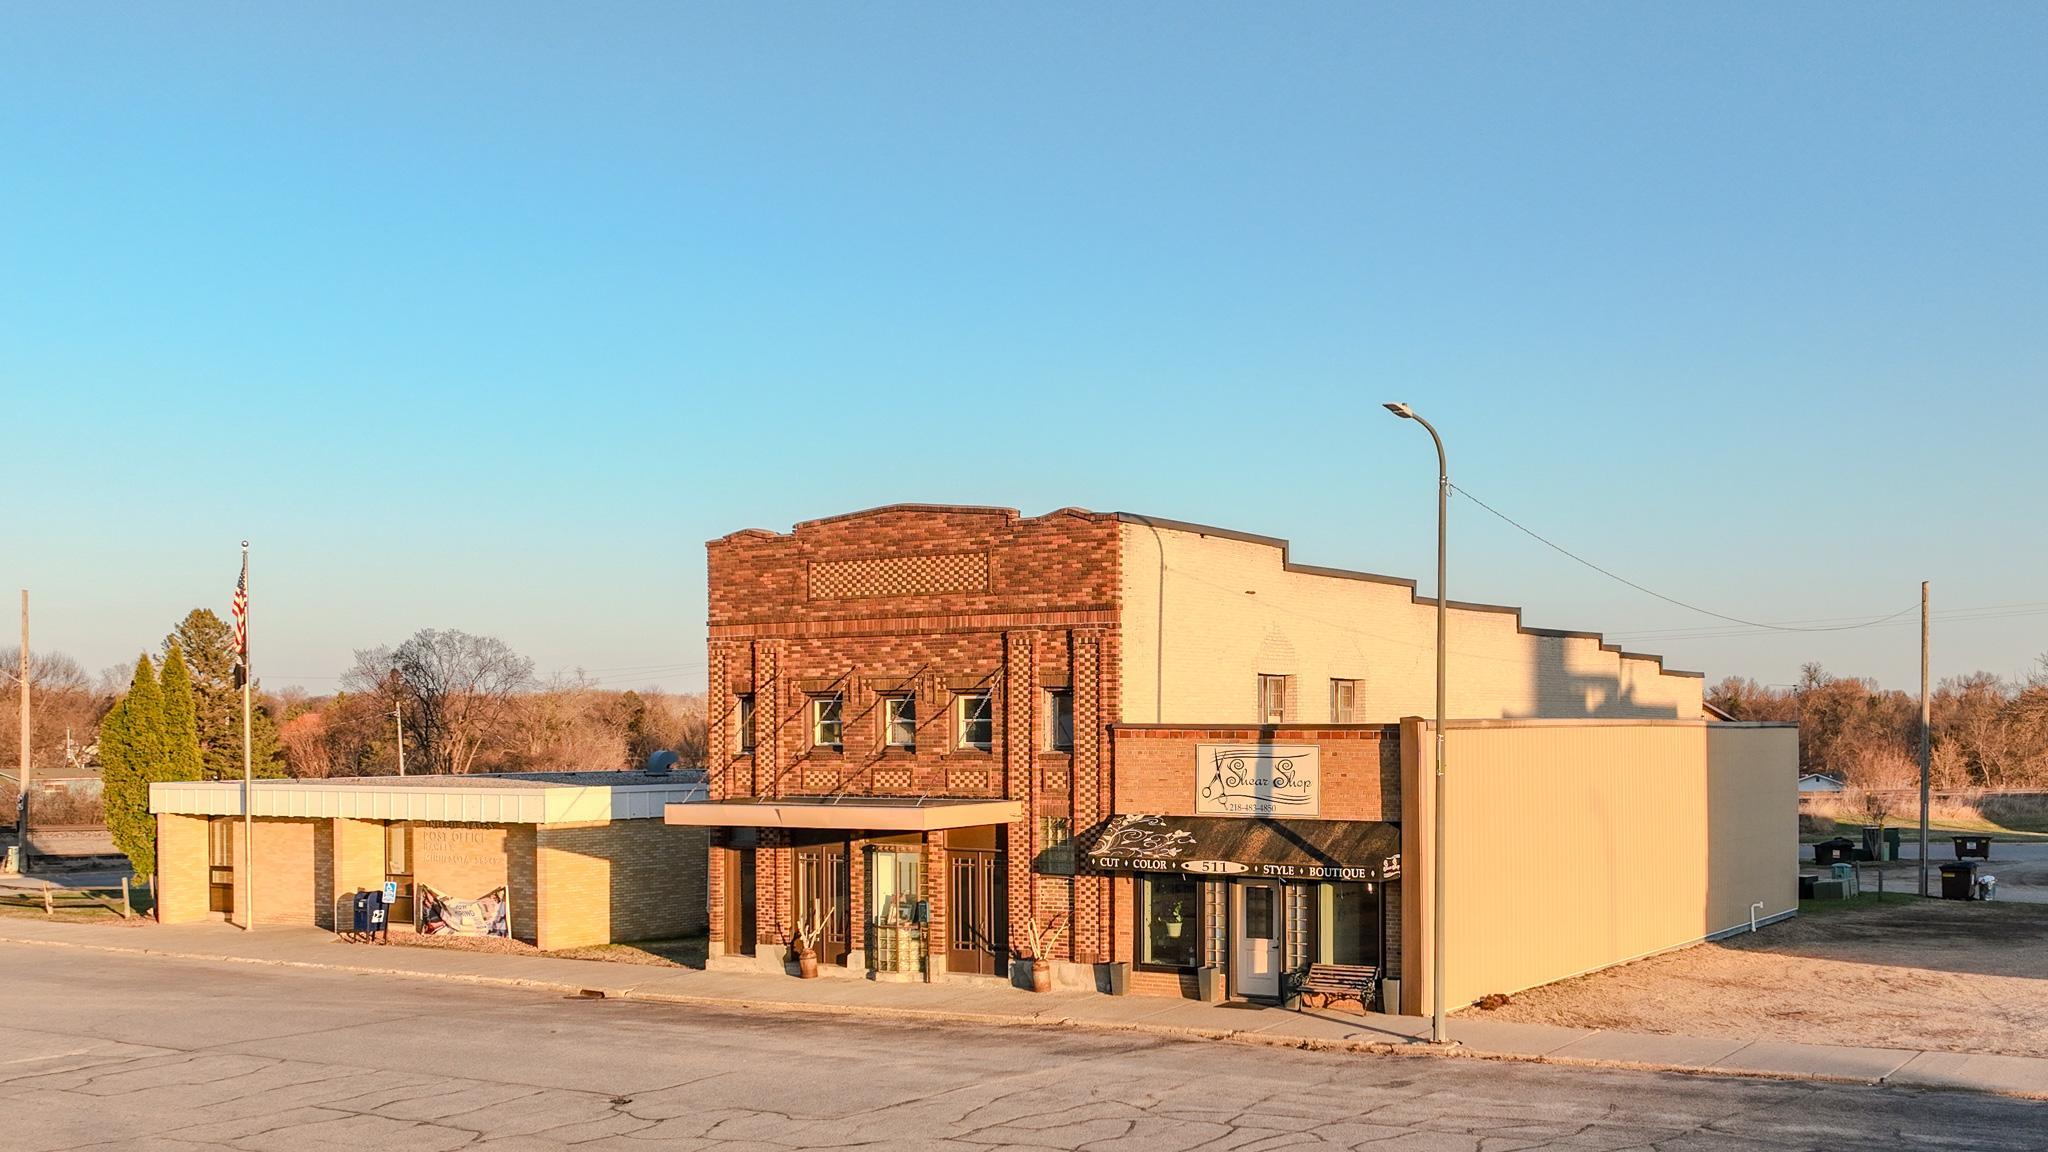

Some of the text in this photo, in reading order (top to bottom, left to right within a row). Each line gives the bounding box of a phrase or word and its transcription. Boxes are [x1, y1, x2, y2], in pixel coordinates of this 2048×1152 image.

[1225, 758, 1312, 793] Shear Shop
[424, 831, 486, 843] POST OFFICE
[1100, 857, 1366, 880] CUT COLOR 511 STYLE BOUTIQUE
